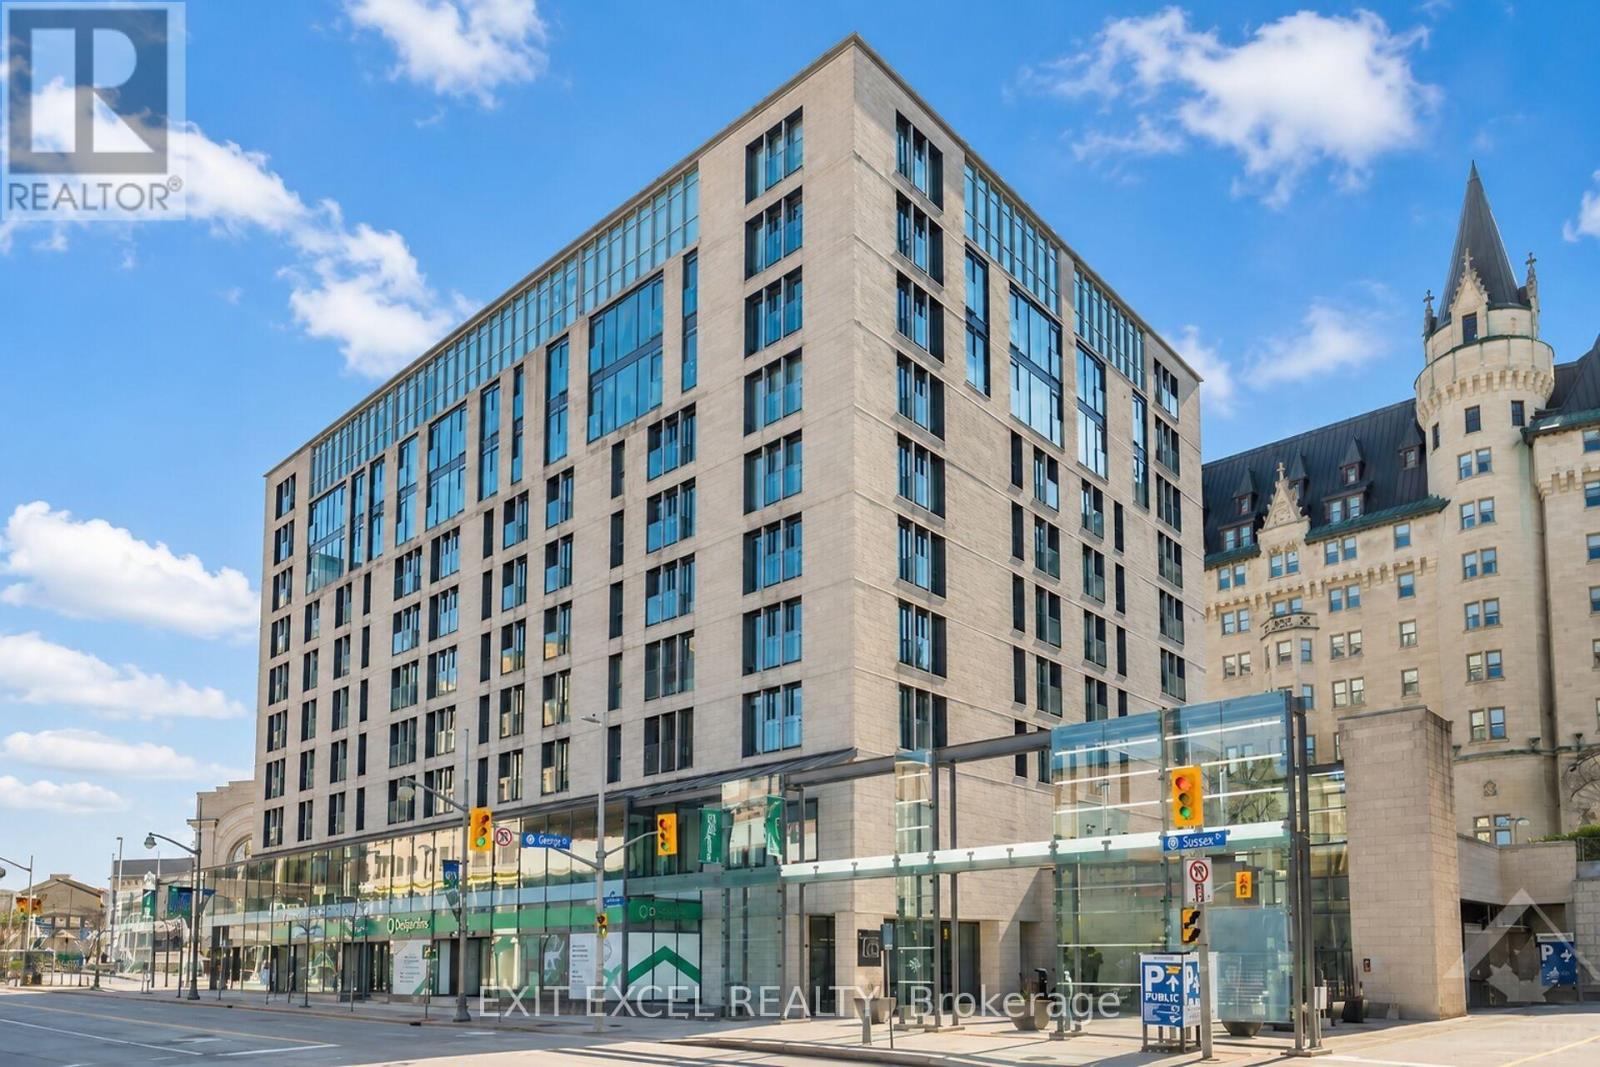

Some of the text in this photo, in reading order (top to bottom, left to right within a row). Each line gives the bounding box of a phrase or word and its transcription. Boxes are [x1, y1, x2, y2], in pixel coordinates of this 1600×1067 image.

[1182, 835, 1214, 848] Sussex
[1541, 944, 1554, 961] P
[1144, 965, 1165, 992] P
[1145, 992, 1180, 1003] PUBLIC
